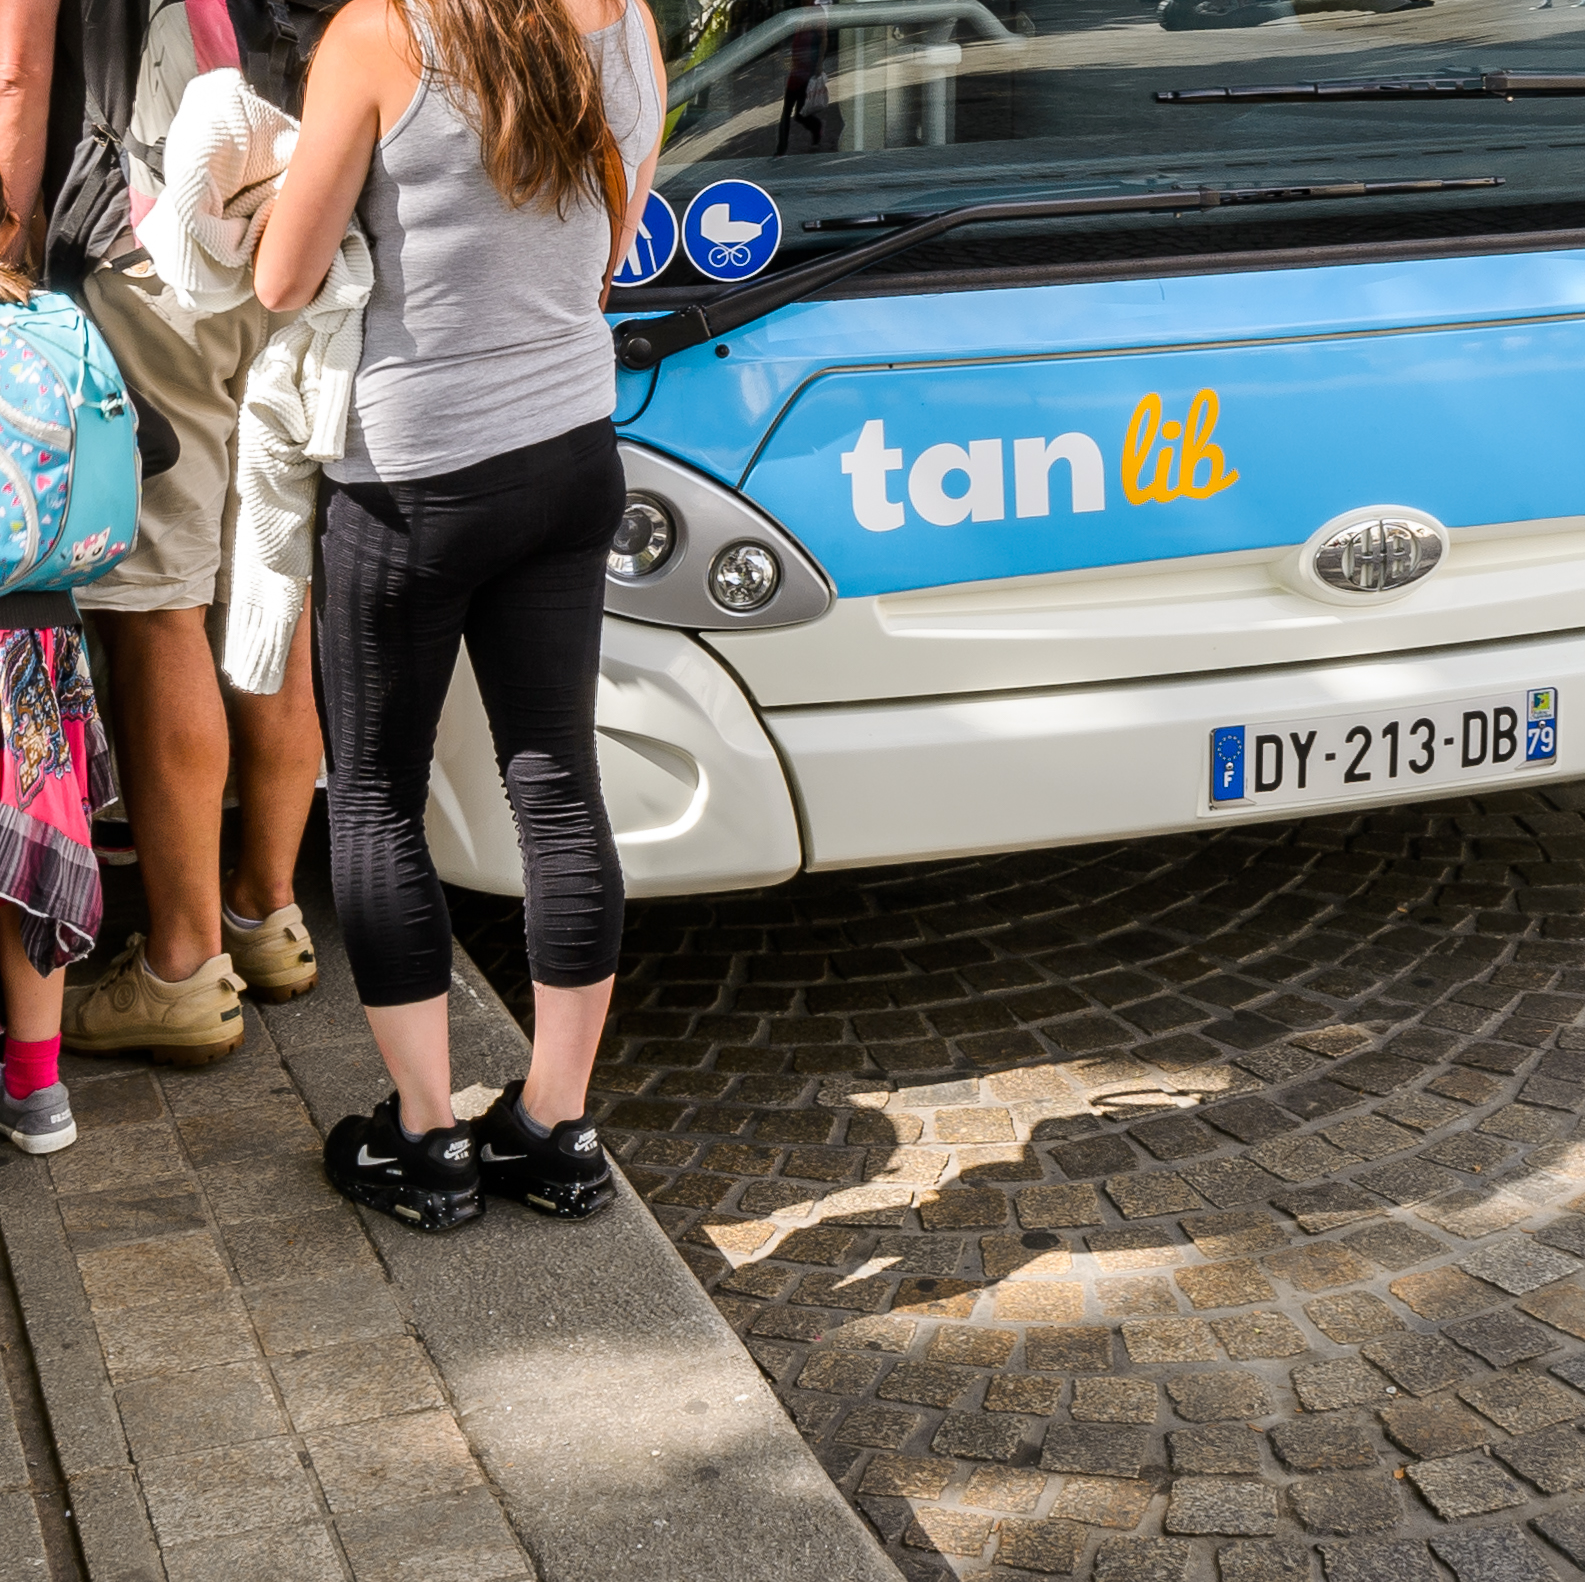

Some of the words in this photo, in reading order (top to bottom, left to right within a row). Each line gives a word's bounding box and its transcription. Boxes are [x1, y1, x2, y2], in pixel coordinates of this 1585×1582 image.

[840, 418, 1106, 533] tan
[1120, 387, 1241, 508] lib
[1223, 770, 1235, 788] F
[1254, 705, 1519, 794] DY-213-DB
[1527, 726, 1554, 756] 79
[453, 1150, 469, 1161] AIR
